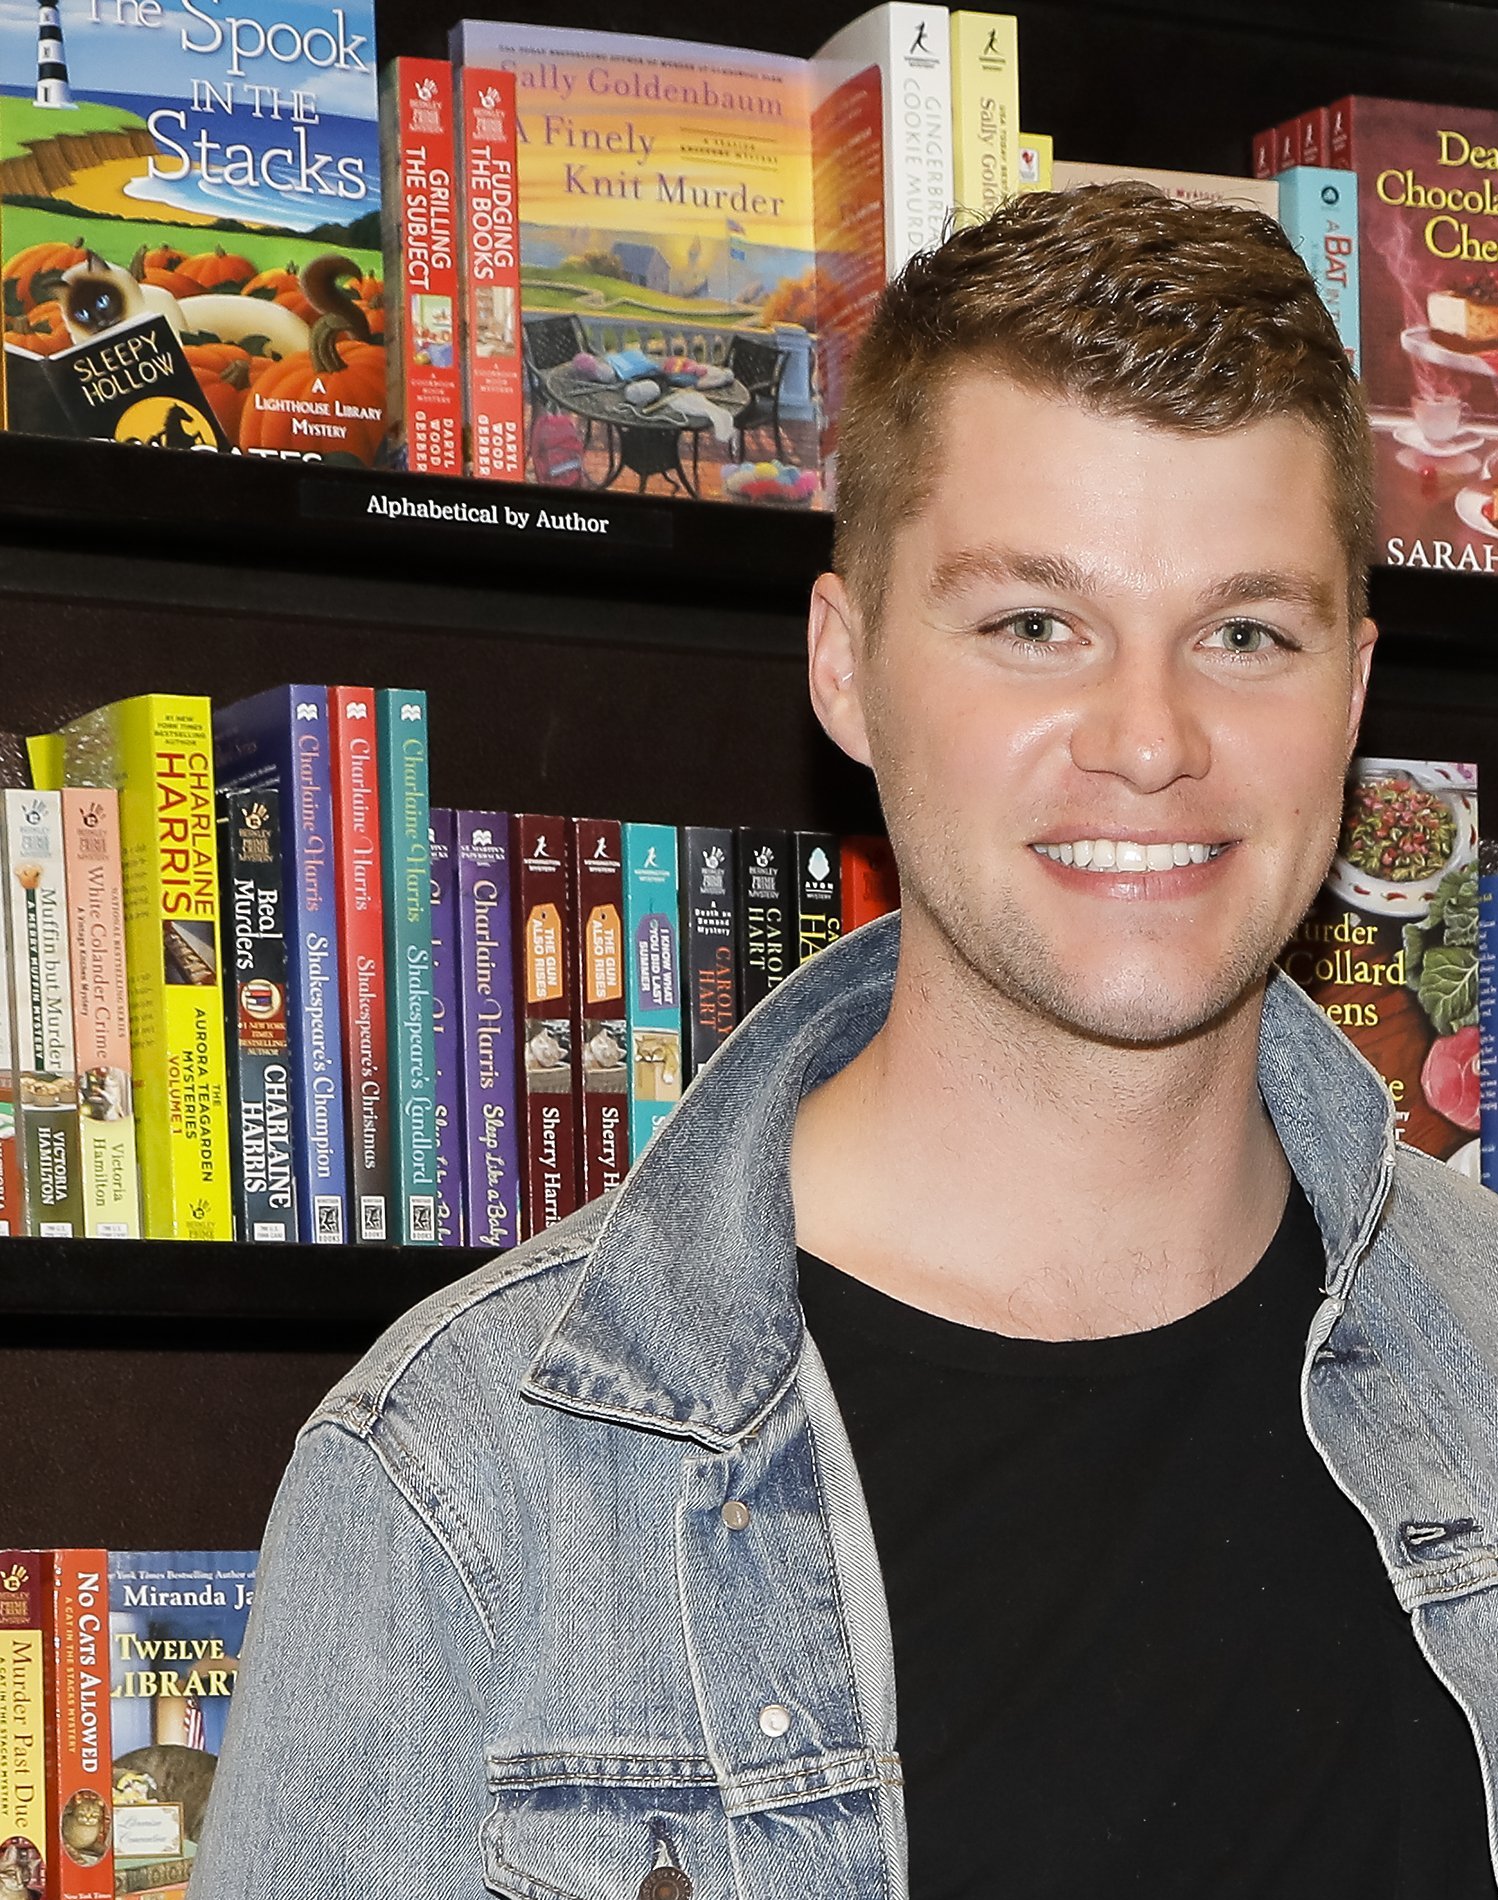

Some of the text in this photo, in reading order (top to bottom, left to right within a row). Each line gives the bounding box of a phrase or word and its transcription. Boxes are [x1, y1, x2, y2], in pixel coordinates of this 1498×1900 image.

[181, 0, 371, 76] Spook
[191, 79, 319, 125] IN THE
[588, 68, 783, 116] Goldenbaum
[146, 109, 368, 200] Stacks
[406, 146, 427, 188] THE
[471, 146, 492, 190] THE
[545, 115, 654, 165] Finely
[429, 169, 452, 270] GRILLING
[492, 160, 514, 268] FUDGING
[565, 163, 784, 217] Knit Murder
[407, 199, 430, 291] SUBJECT
[472, 199, 494, 280] BOOKS
[73, 329, 161, 384] SLEEPY
[82, 351, 174, 407] HOLLOW
[367, 494, 610, 534] Alphabetical by Author
[155, 753, 191, 915] HARRIS
[188, 753, 216, 915] CHARLAINE
[257, 889, 283, 941] Real
[402, 737, 430, 1091] Charlaine Harris Shakespeare's
[805, 882, 834, 890] AVON
[232, 878, 255, 971] Murders
[298, 733, 336, 1180] Charlaine Harris Shakespeare's Champion
[349, 737, 381, 1170] Charlaine Harris Shakespeare's Christmas
[473, 879, 500, 996] Charlaine
[748, 907, 766, 971] HART
[87, 866, 111, 1059] White Crime
[659, 934, 675, 1006] KNOW WHAT
[698, 969, 717, 1030] HART
[46, 997, 66, 1071] Murder
[477, 998, 503, 1090] Harris
[168, 1055, 182, 1124] VOLUME
[182, 1050, 198, 1140] MYSTERIES
[195, 1007, 214, 1182] AURORA TEAGARDEN
[52, 1131, 69, 1201] VICTORIA
[241, 1101, 267, 1194] HARRIS
[538, 1106, 561, 1169] Sherry
[597, 1106, 620, 1169] Sherry
[122, 1584, 227, 1607] Miranda
[77, 1571, 102, 1774] NO CATS ALLOWED
[115, 1632, 225, 1661] TWELVE
[12, 1640, 36, 1829] Murder Past Due
